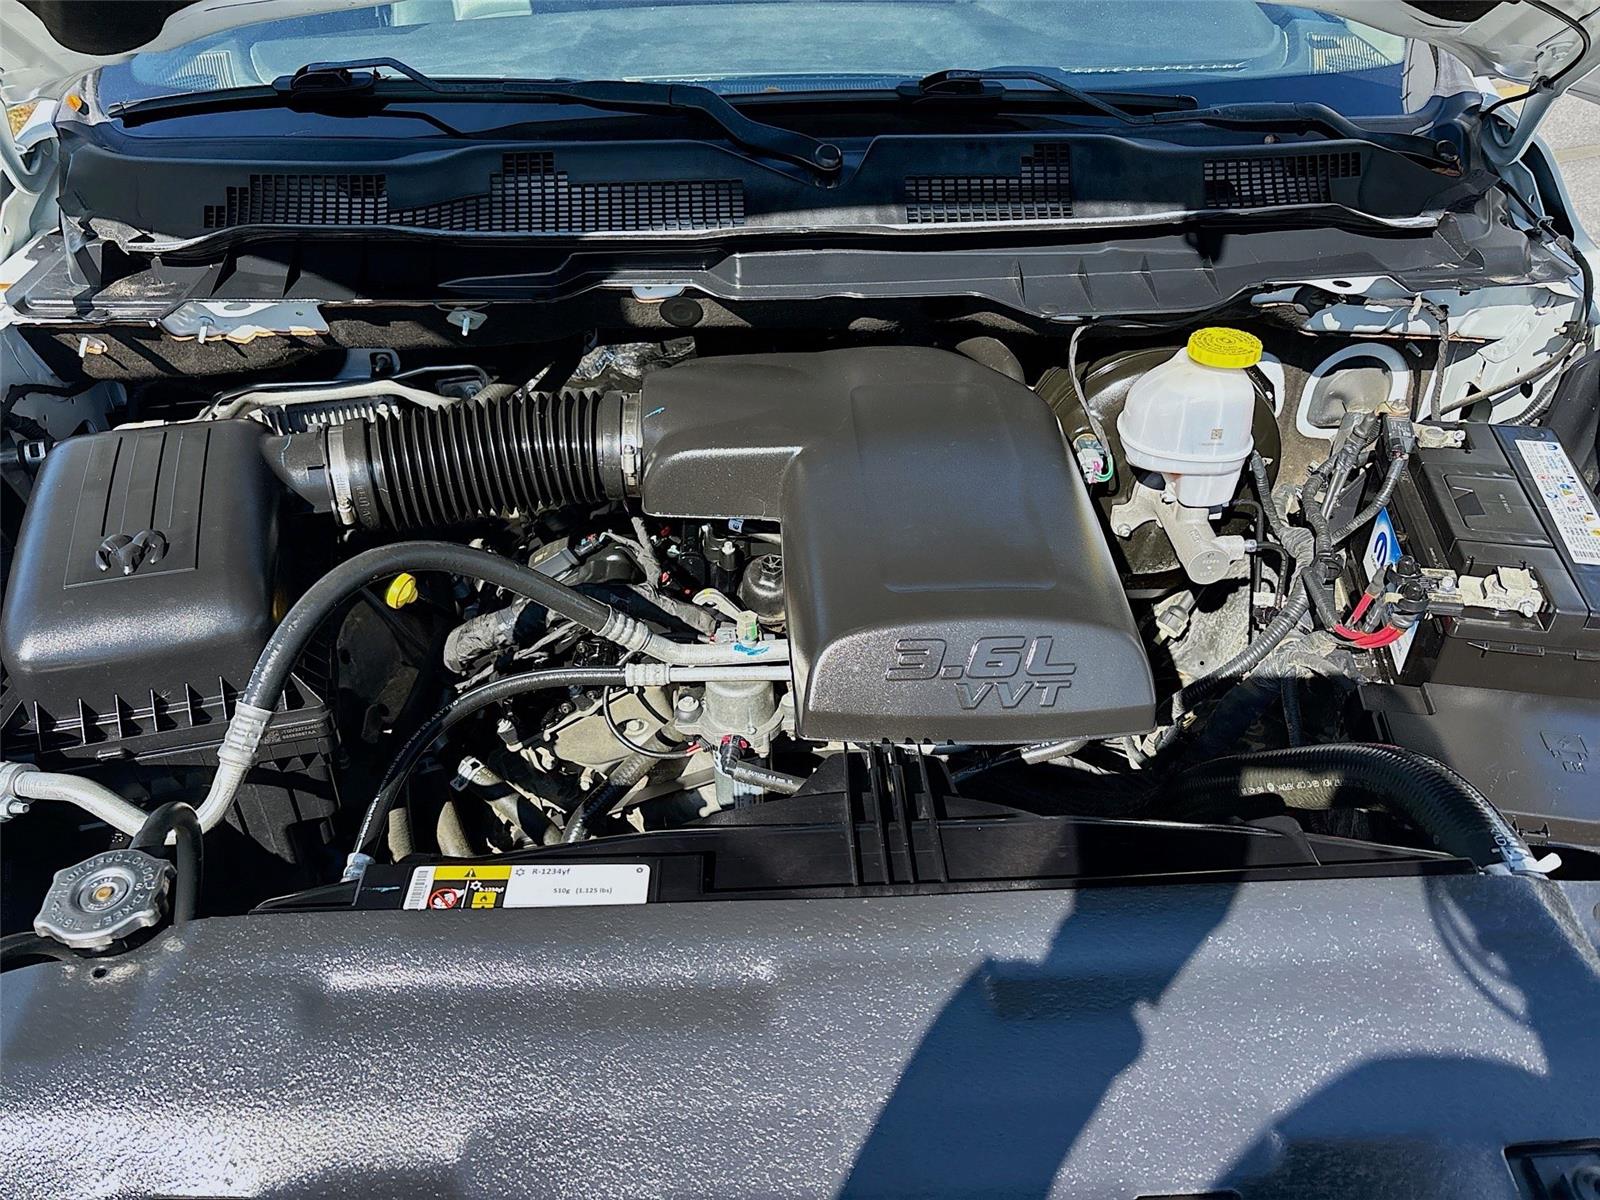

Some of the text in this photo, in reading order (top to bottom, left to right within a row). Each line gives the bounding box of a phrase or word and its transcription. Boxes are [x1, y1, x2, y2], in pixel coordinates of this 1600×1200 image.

[885, 635, 1077, 681] 3.6L
[954, 680, 1072, 710] VVT
[532, 868, 570, 877] R-1234yf
[92, 903, 134, 930] KEEP
